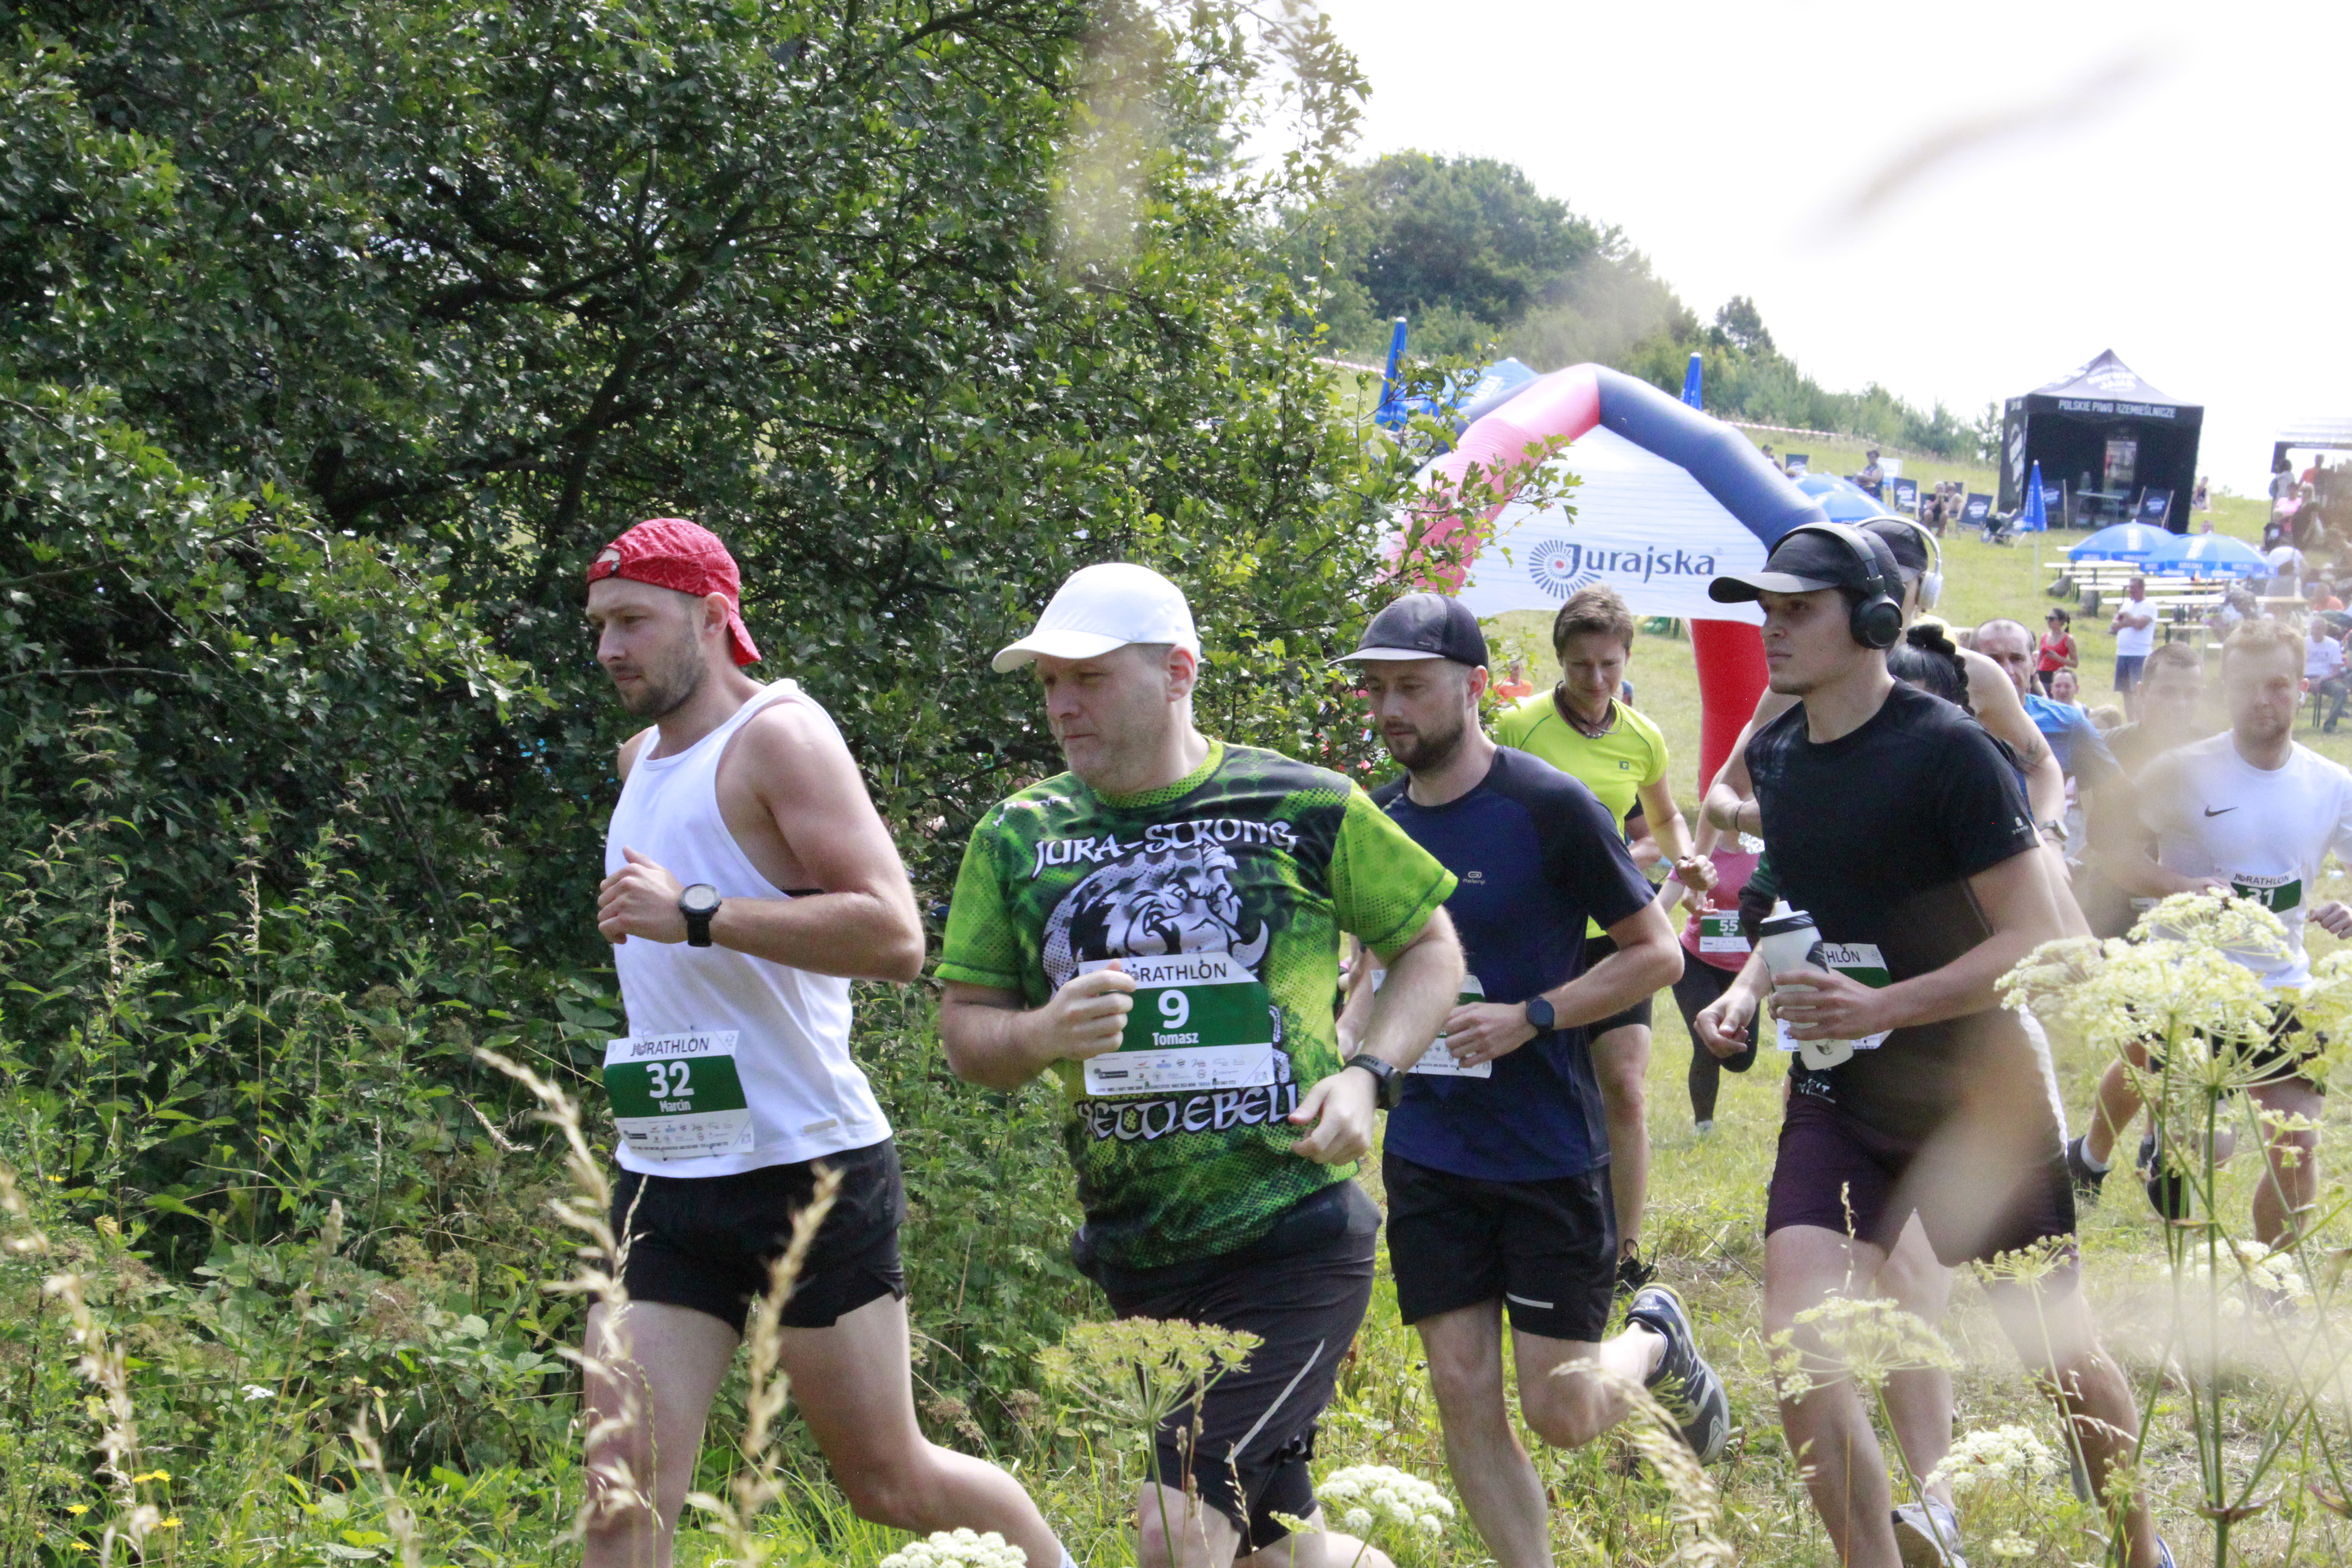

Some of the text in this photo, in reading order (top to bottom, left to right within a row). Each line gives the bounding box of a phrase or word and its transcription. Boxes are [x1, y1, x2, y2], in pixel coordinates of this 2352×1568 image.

[2058, 399, 2091, 411] POLSKIE
[2092, 401, 2114, 413] PIWO
[1566, 543, 1715, 584] Jurajska
[1719, 920, 1738, 932] 55
[1133, 963, 1227, 982] RATHLON
[1158, 989, 1189, 1029] 9
[1152, 1032, 1199, 1046] Tomasz
[646, 1061, 695, 1099] 32
[659, 1099, 691, 1112] Marcin
